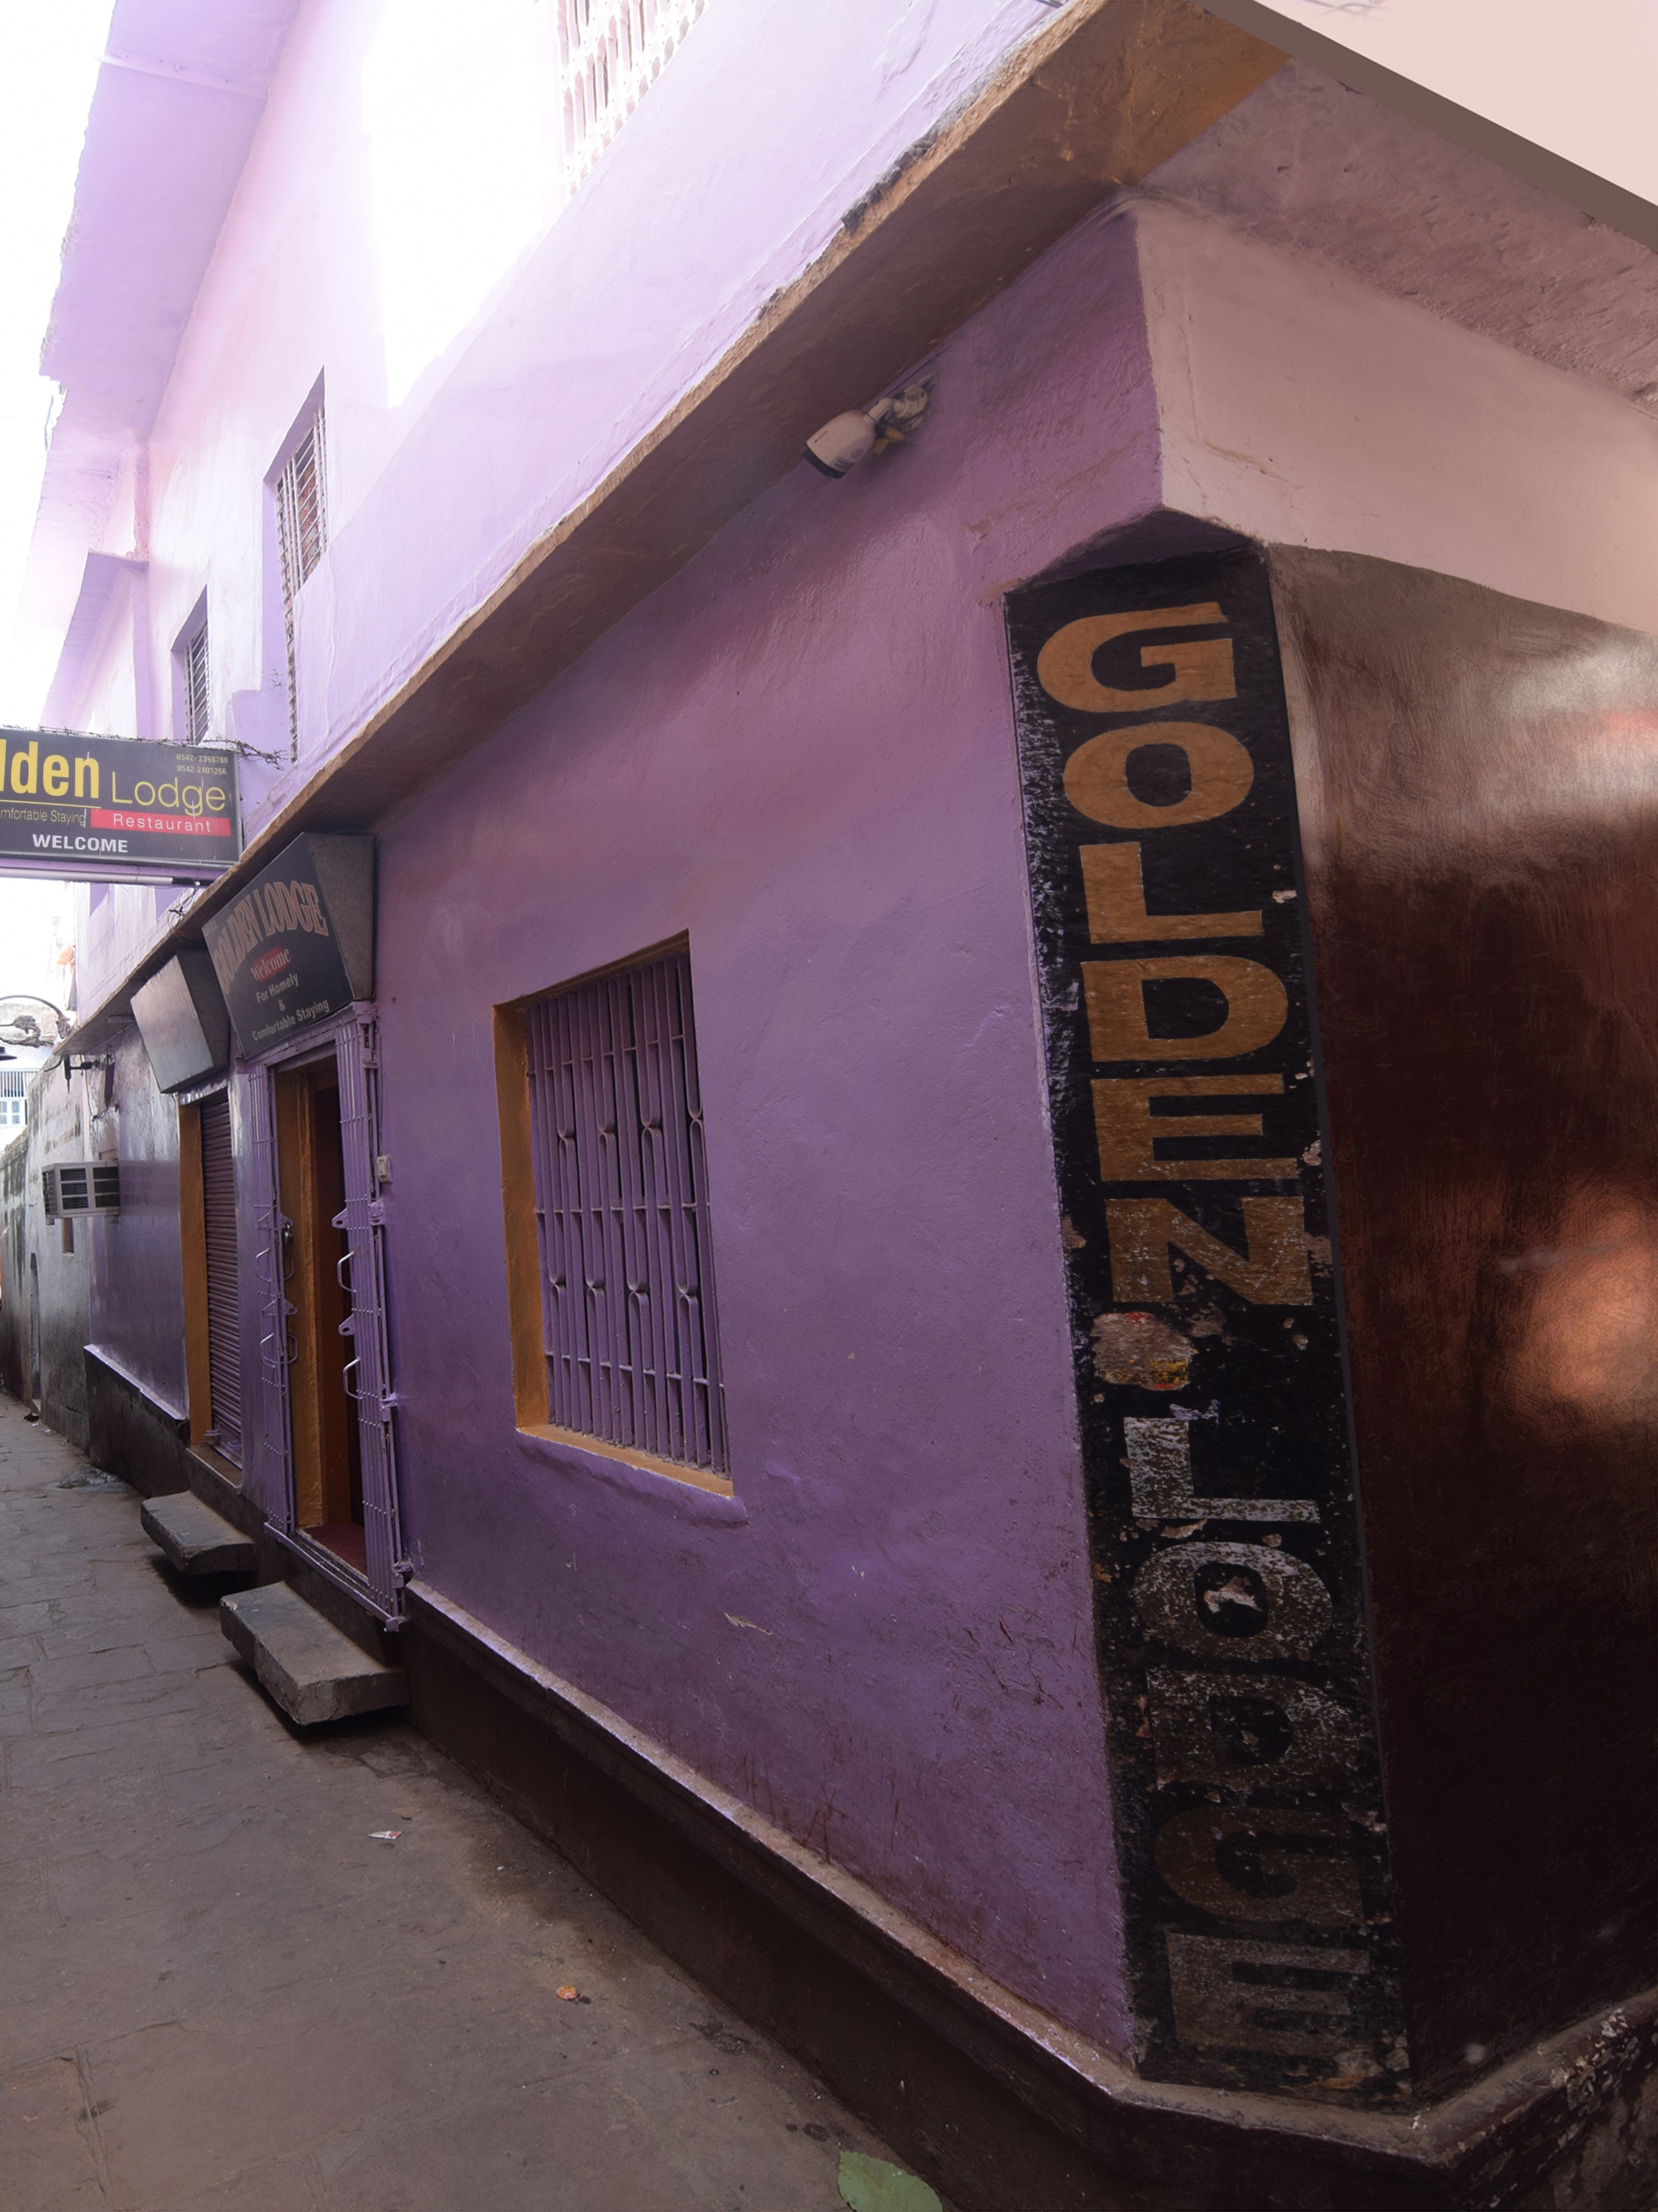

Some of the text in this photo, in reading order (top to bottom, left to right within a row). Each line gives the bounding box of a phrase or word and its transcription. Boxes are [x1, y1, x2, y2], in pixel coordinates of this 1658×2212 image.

[112, 771, 226, 817] Lodge
[50, 810, 86, 827] Staying
[113, 813, 211, 832] Restaurant
[32, 834, 128, 853] WELCOME
[213, 880, 329, 994] GOLDEN LODGE
[250, 948, 291, 982] Welcome
[255, 973, 299, 1003] For Homely
[252, 1000, 330, 1041] Comfortable Staying
[278, 999, 286, 1011] &
[1036, 602, 1371, 2057] GOLDEN LODGE
